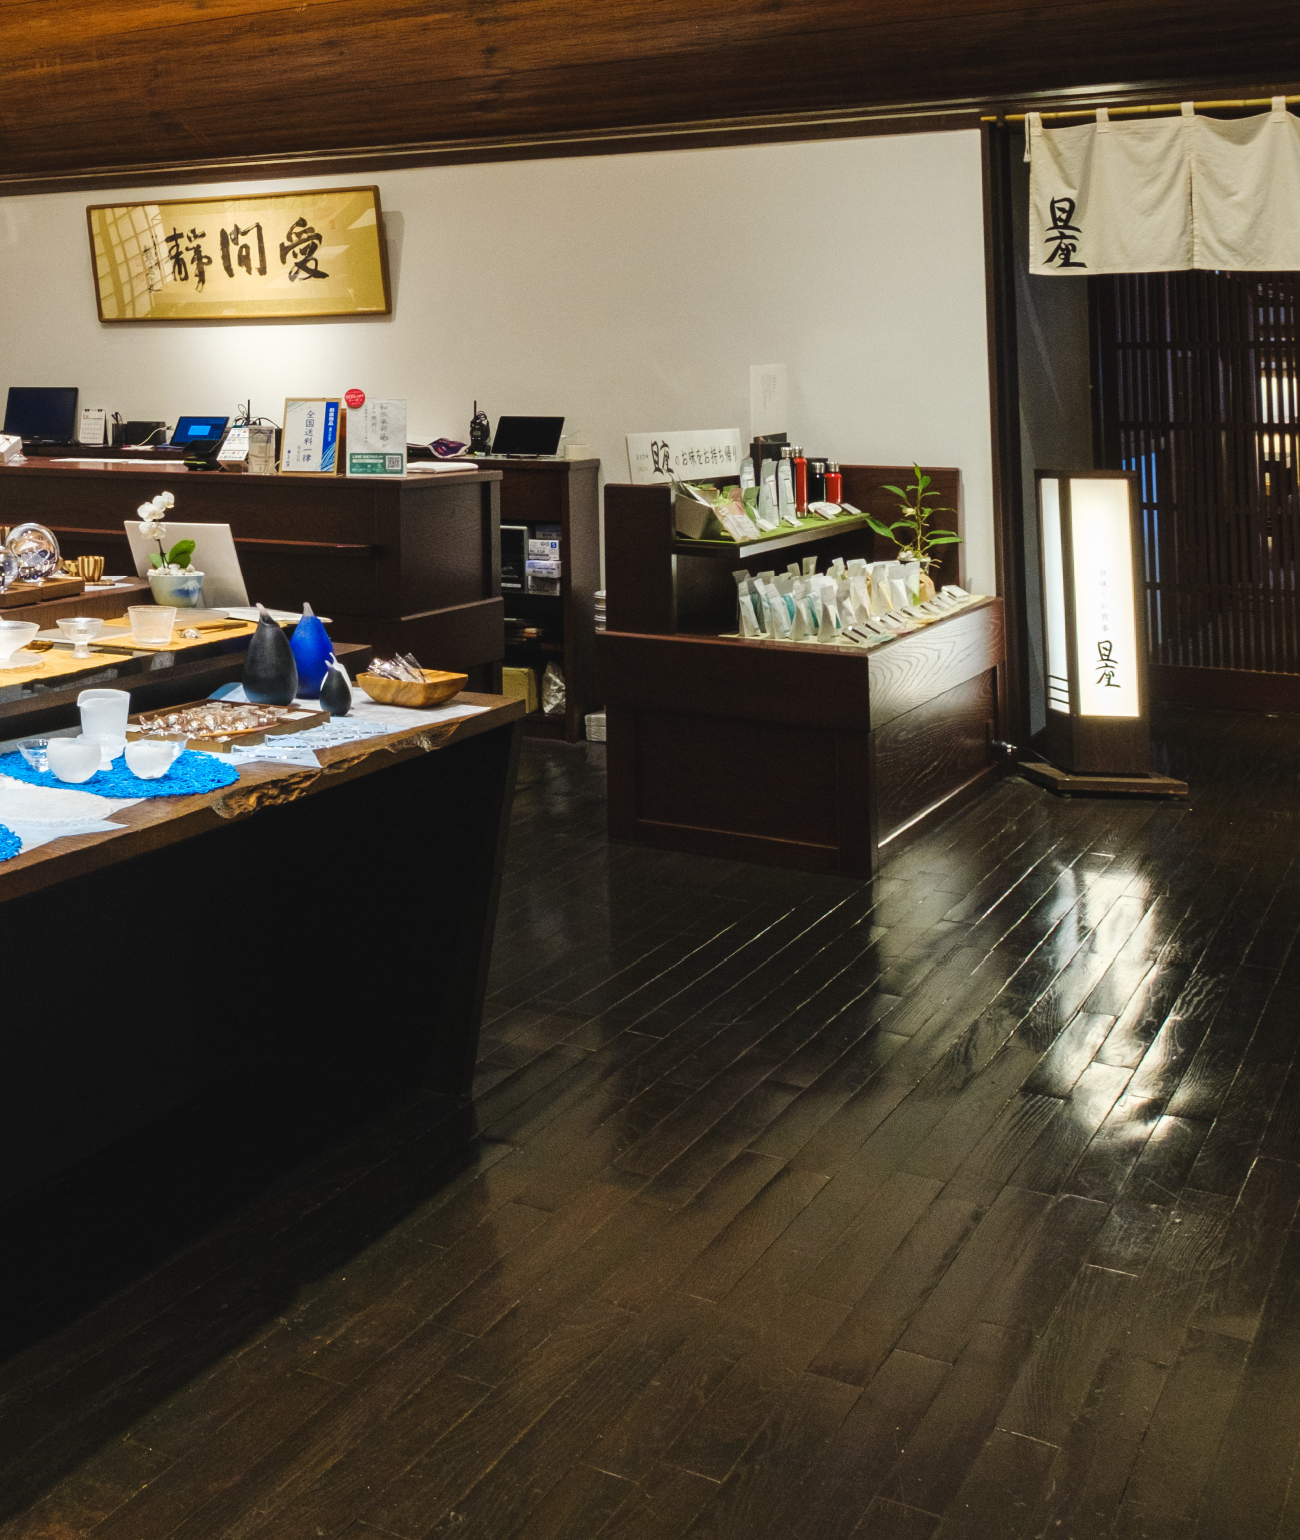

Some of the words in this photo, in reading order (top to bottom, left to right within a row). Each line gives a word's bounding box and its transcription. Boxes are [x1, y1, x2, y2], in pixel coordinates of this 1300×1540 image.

[1042, 196, 1088, 268] 旦座
[302, 409, 316, 463] 全国送料一律
[1095, 640, 1122, 688] 旦座
